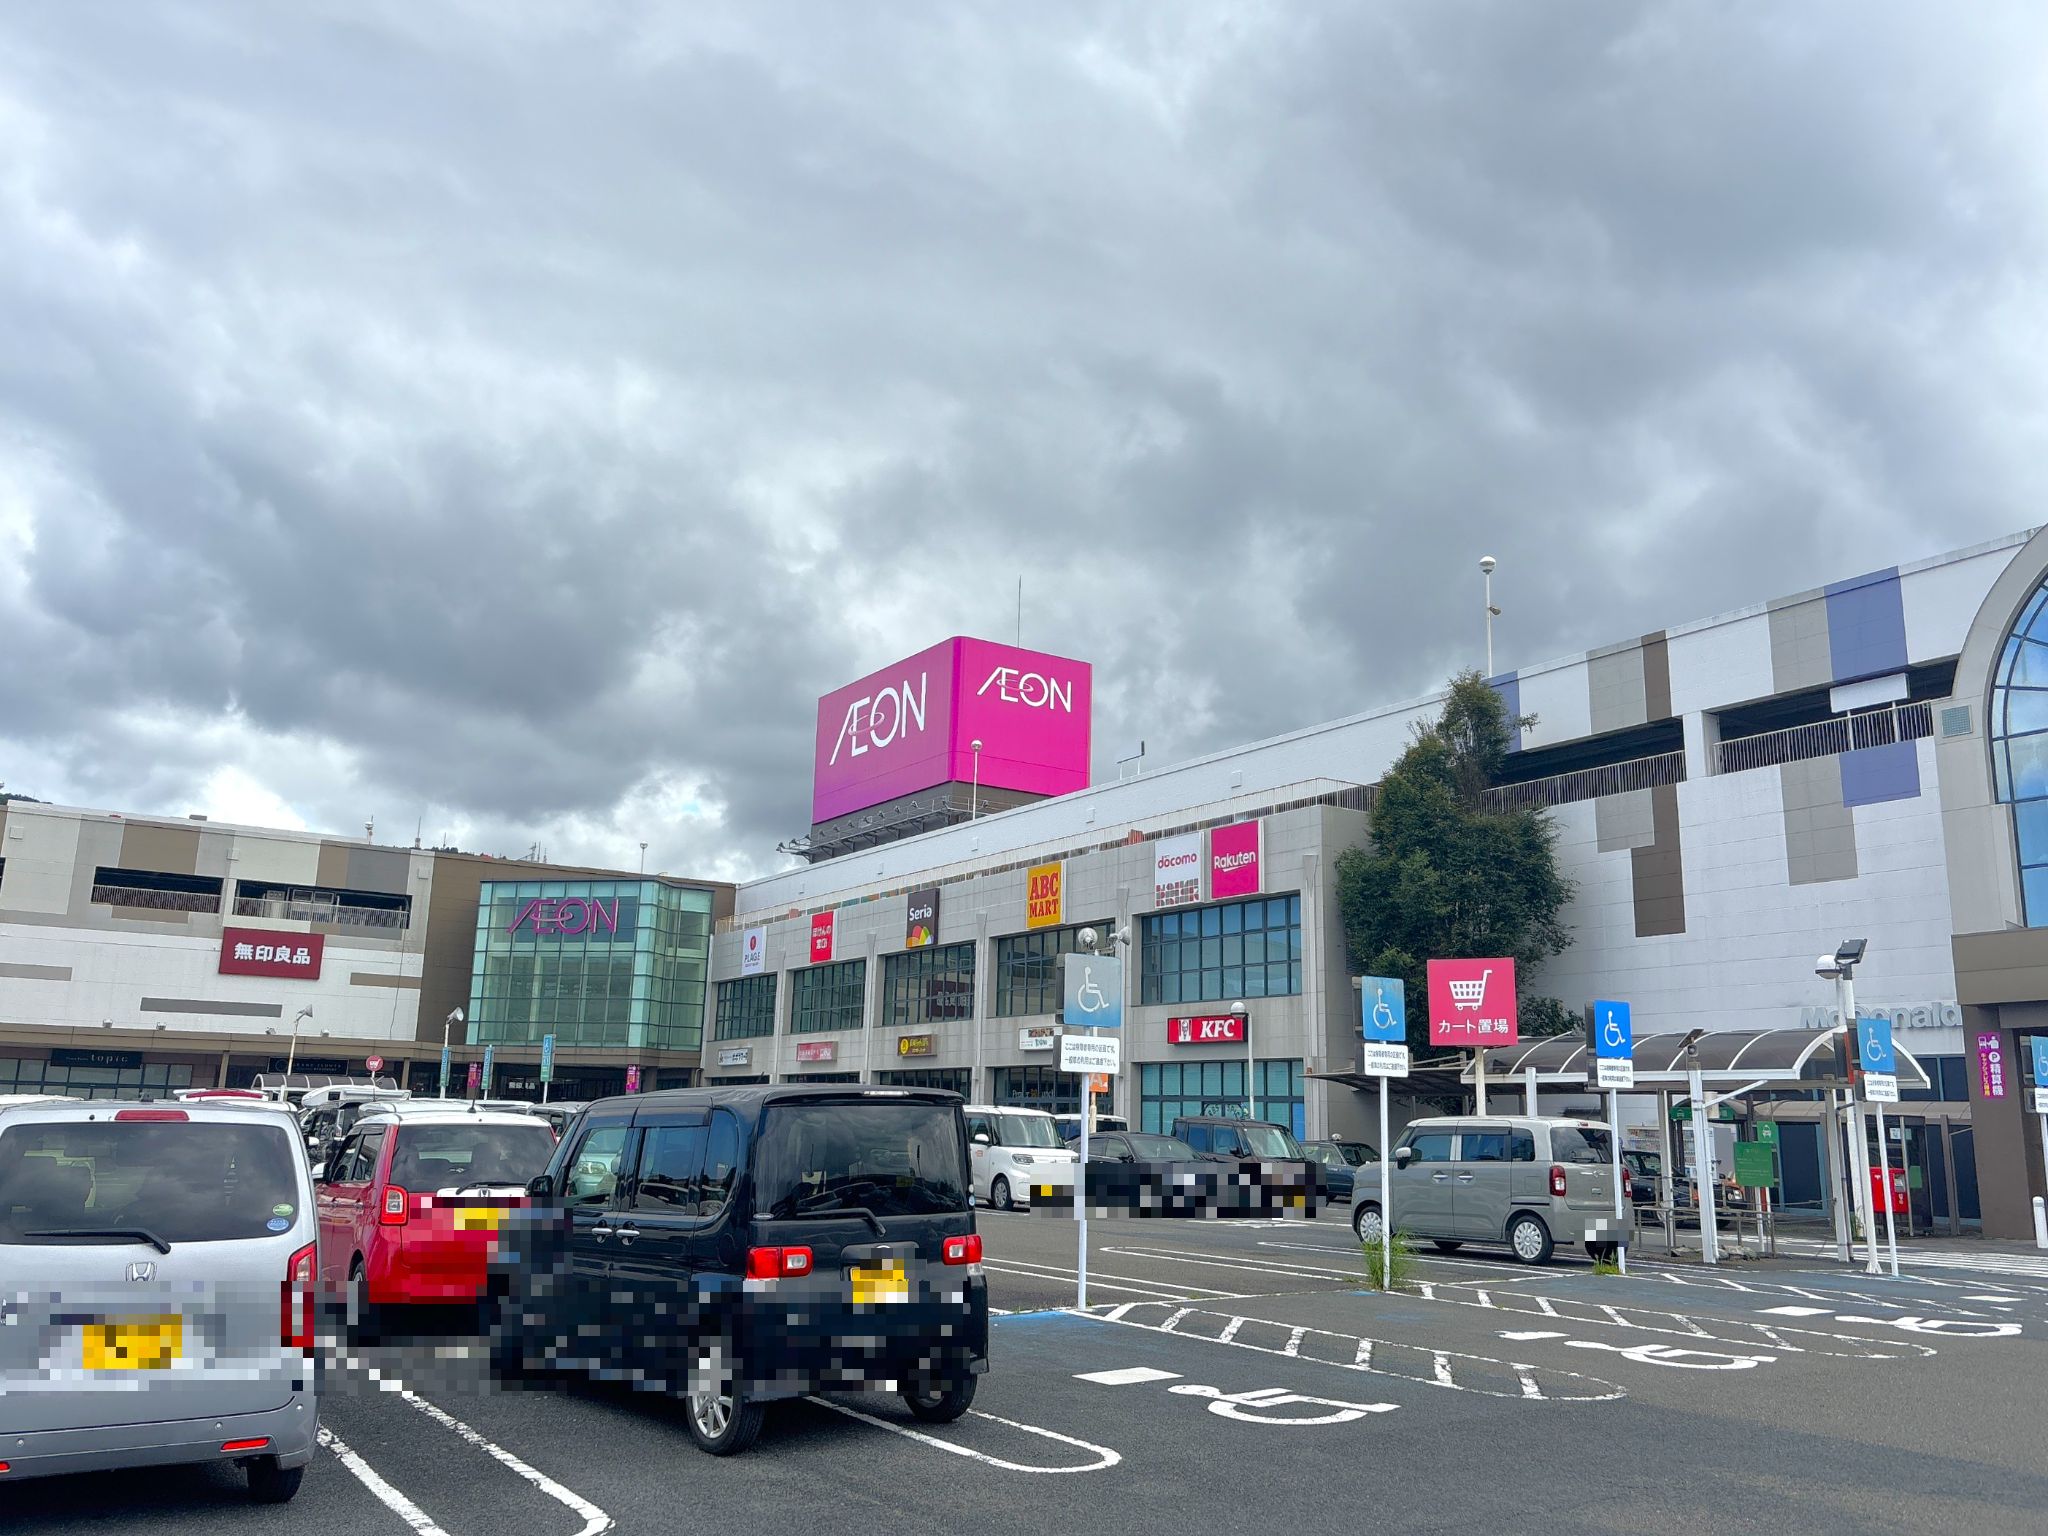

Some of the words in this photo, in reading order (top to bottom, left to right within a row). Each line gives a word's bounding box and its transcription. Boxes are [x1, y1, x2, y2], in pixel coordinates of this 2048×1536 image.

[1157, 853, 1198, 869] docomo
[1213, 851, 1256, 869] Rakuten
[1029, 872, 1059, 901] ABC
[909, 904, 932, 921] Seria
[1029, 898, 1059, 919] MART
[233, 942, 311, 965] 無印良品
[744, 951, 761, 963] PLAGE
[1200, 1019, 1235, 1038] KFC
[1438, 1018, 1509, 1034] カート置場
[91, 1054, 128, 1065] topic
[1990, 1063, 2004, 1096] 精算機
